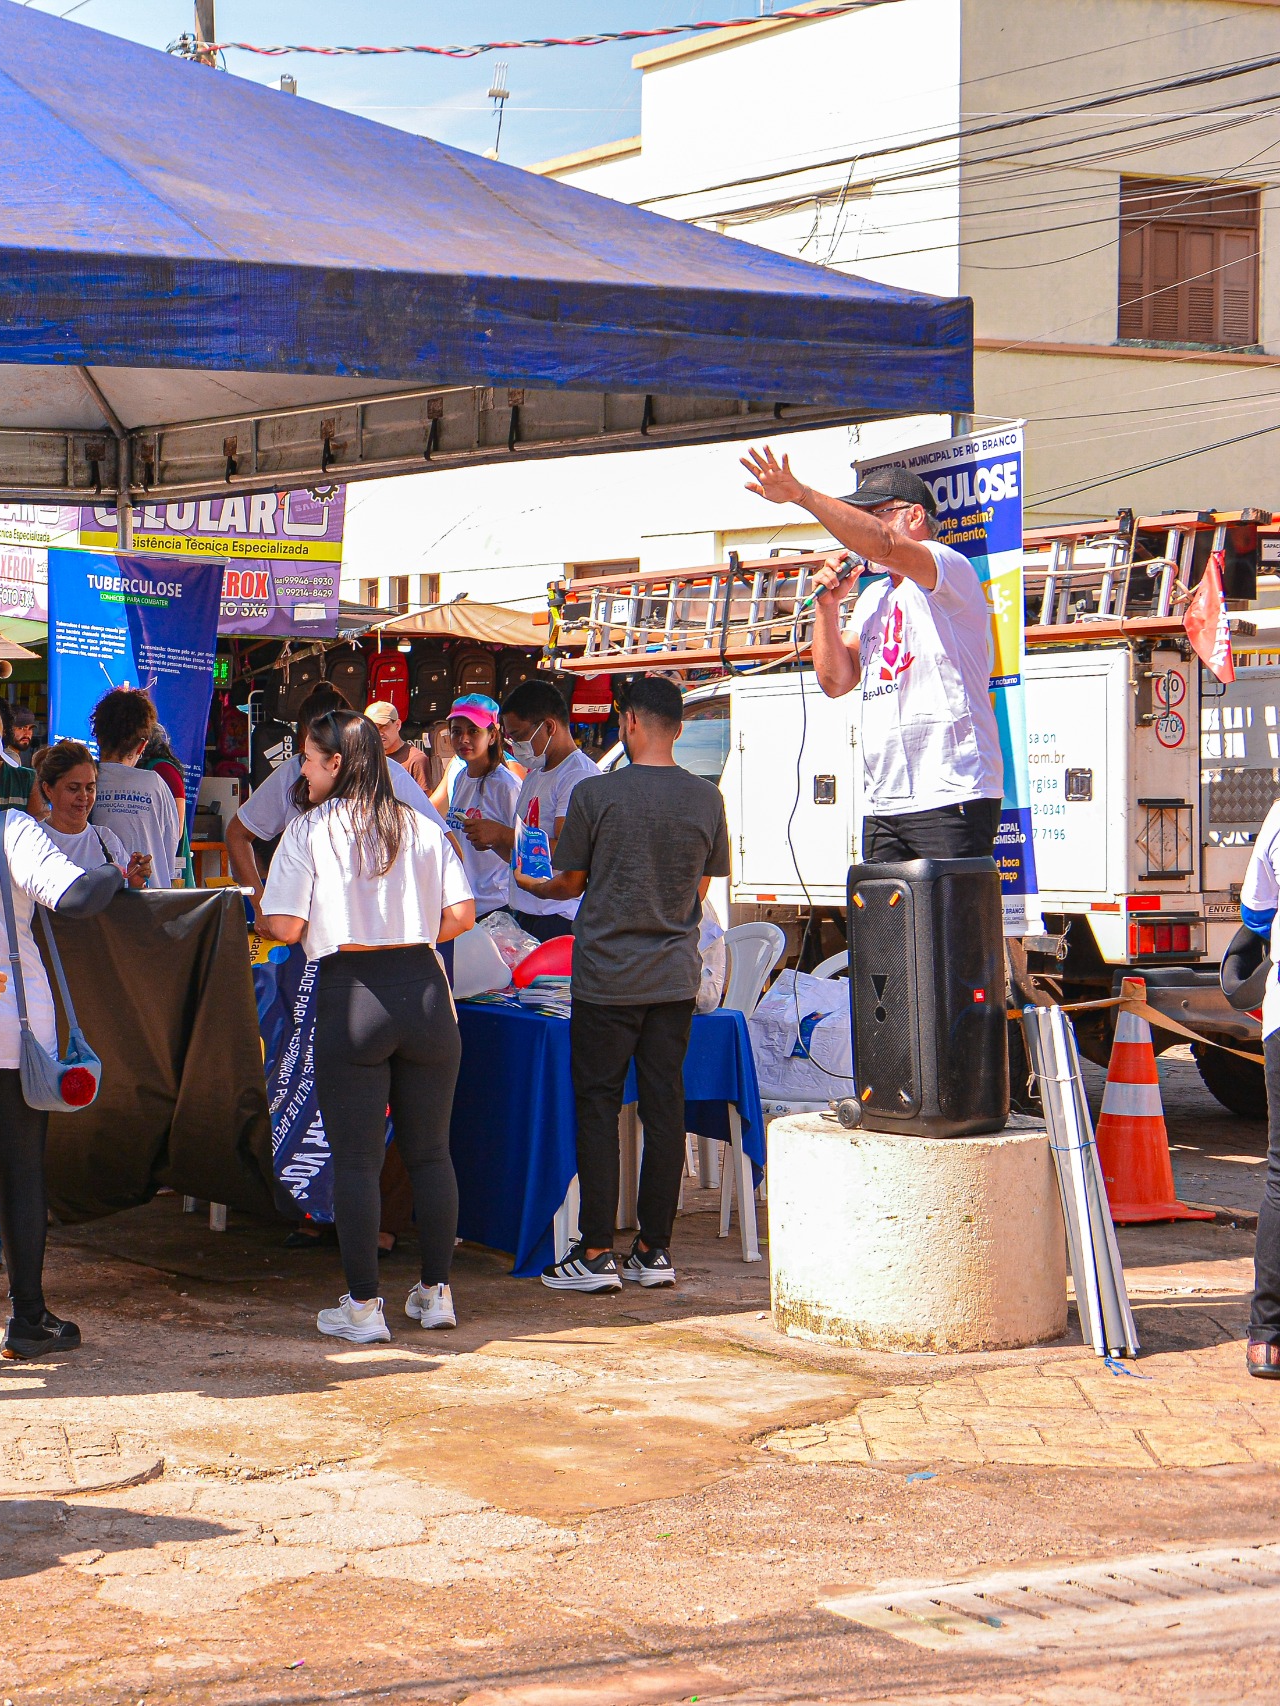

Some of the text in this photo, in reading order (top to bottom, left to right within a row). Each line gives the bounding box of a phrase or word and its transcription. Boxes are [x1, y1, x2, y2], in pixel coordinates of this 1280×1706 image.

[908, 449, 951, 469] MUNICIPAL
[953, 445, 964, 458] DE
[965, 443, 979, 455] RIO
[982, 433, 1018, 451] BRANCO
[925, 460, 1020, 511] CULOSE
[961, 506, 995, 527] assim?
[185, 538, 309, 555] Técnica Especializada
[0, 554, 35, 585] XEROX
[86, 574, 183, 598] TUBERCULOSE
[285, 588, 333, 598] 99214-8429
[19, 589, 35, 608] 3X4
[100, 593, 125, 602] CONHECER
[141, 597, 169, 606] COMBATER
[240, 602, 268, 618] 3X4
[1161, 719, 1178, 733] 70
[114, 794, 152, 804] BRANCO
[1042, 828, 1066, 840] 7196
[1002, 856, 1020, 867] boca
[293, 994, 310, 1025] PARA
[293, 1079, 314, 1106] FALTA
[285, 1101, 300, 1121] DE
